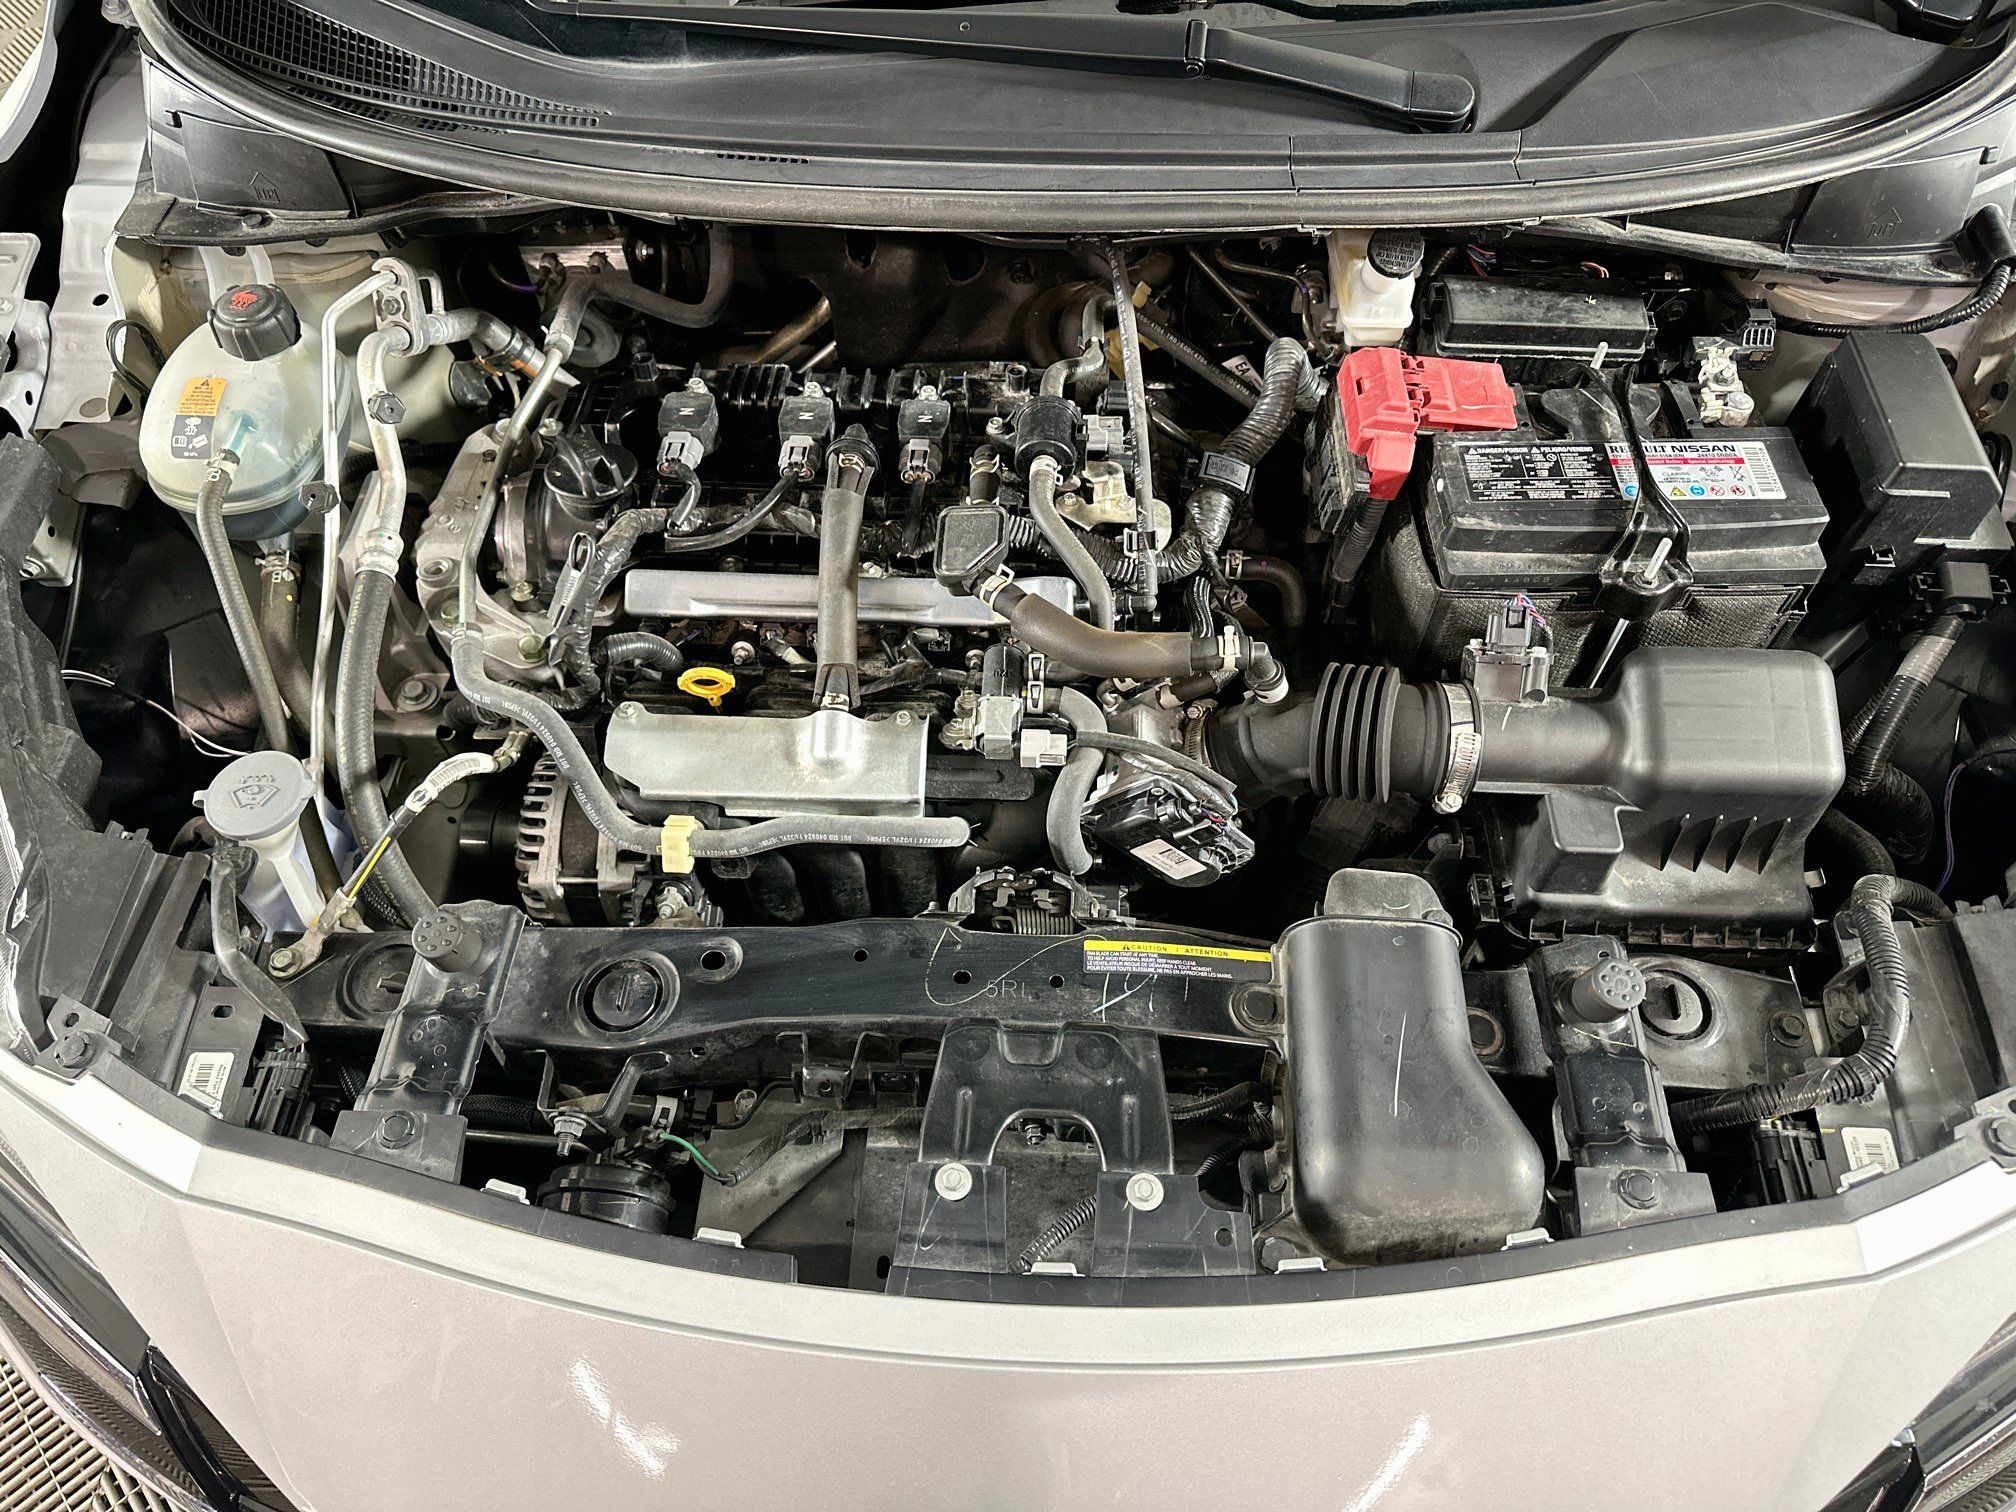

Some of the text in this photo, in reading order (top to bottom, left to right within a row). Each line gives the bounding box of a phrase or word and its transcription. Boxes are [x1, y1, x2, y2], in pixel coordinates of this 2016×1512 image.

[1235, 361, 1251, 376] EA
[1609, 444, 1736, 453] REULT NISSAN
[540, 726, 556, 748] 040524
[1185, 948, 1228, 957] ATTENTION
